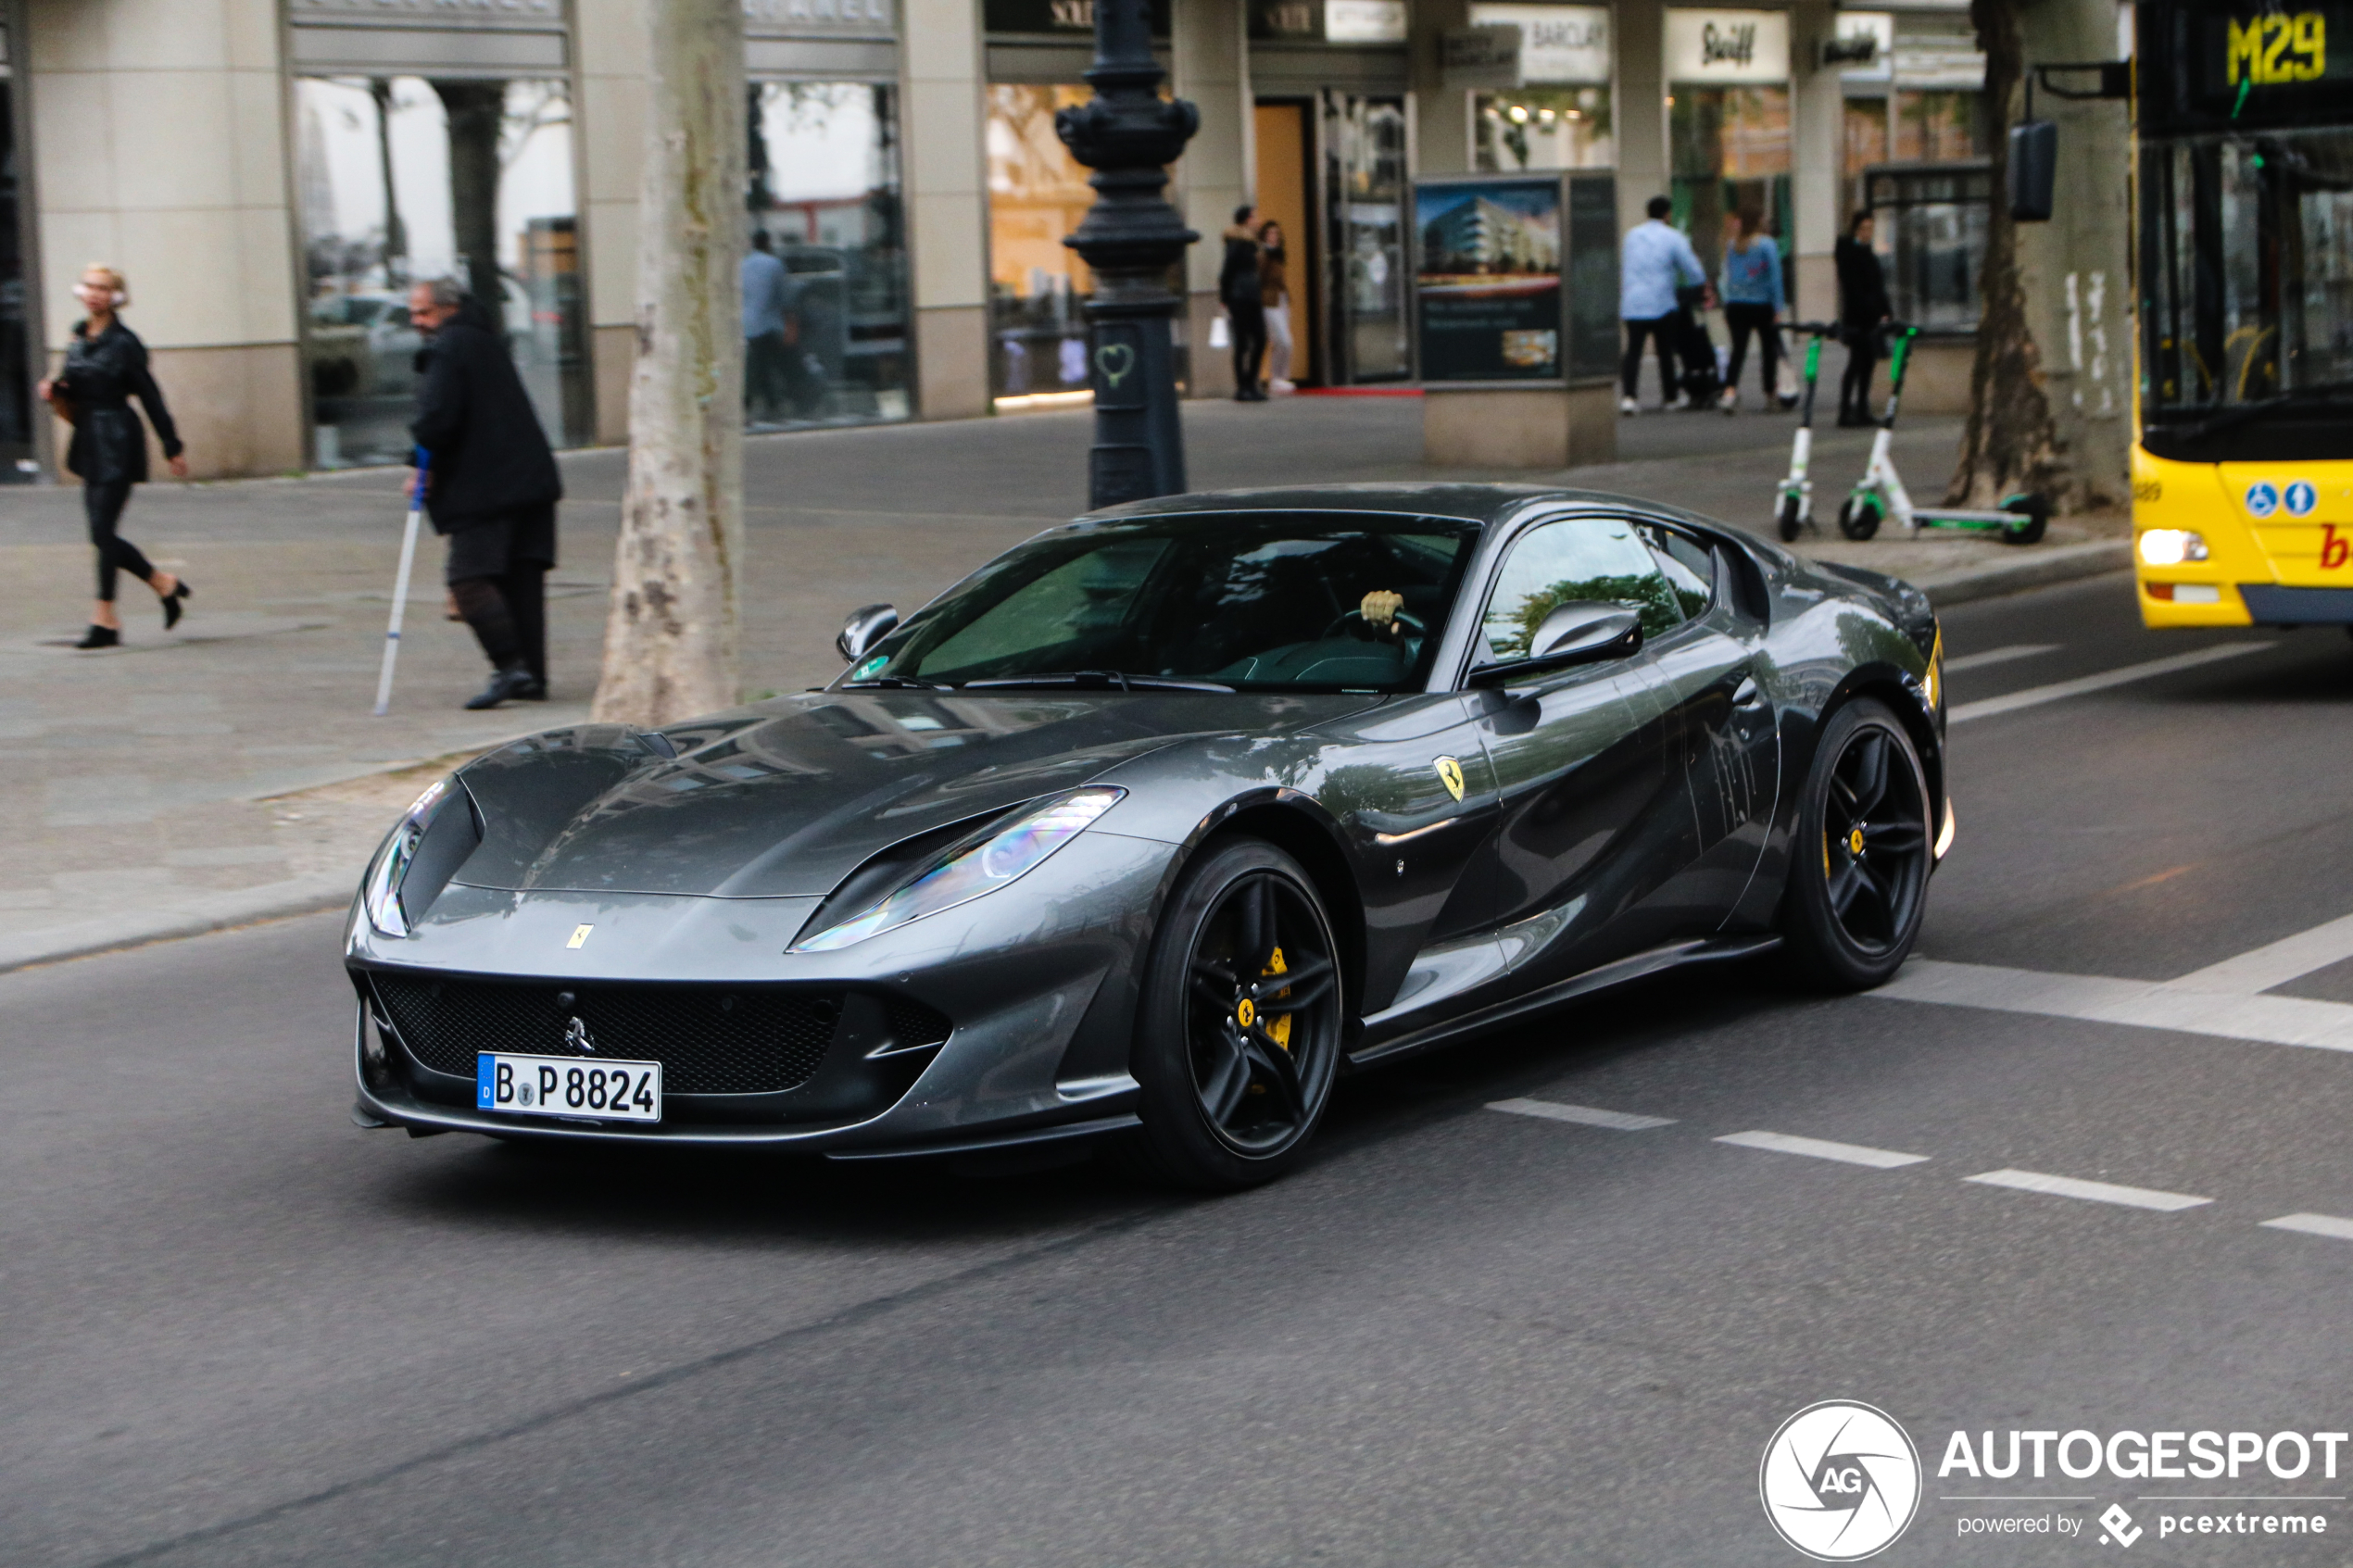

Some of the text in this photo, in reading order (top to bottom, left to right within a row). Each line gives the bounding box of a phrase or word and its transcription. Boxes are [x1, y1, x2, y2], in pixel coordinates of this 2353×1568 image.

[2227, 10, 2326, 86] M29
[482, 1085, 491, 1099] D
[496, 1062, 654, 1112] B P 8824
